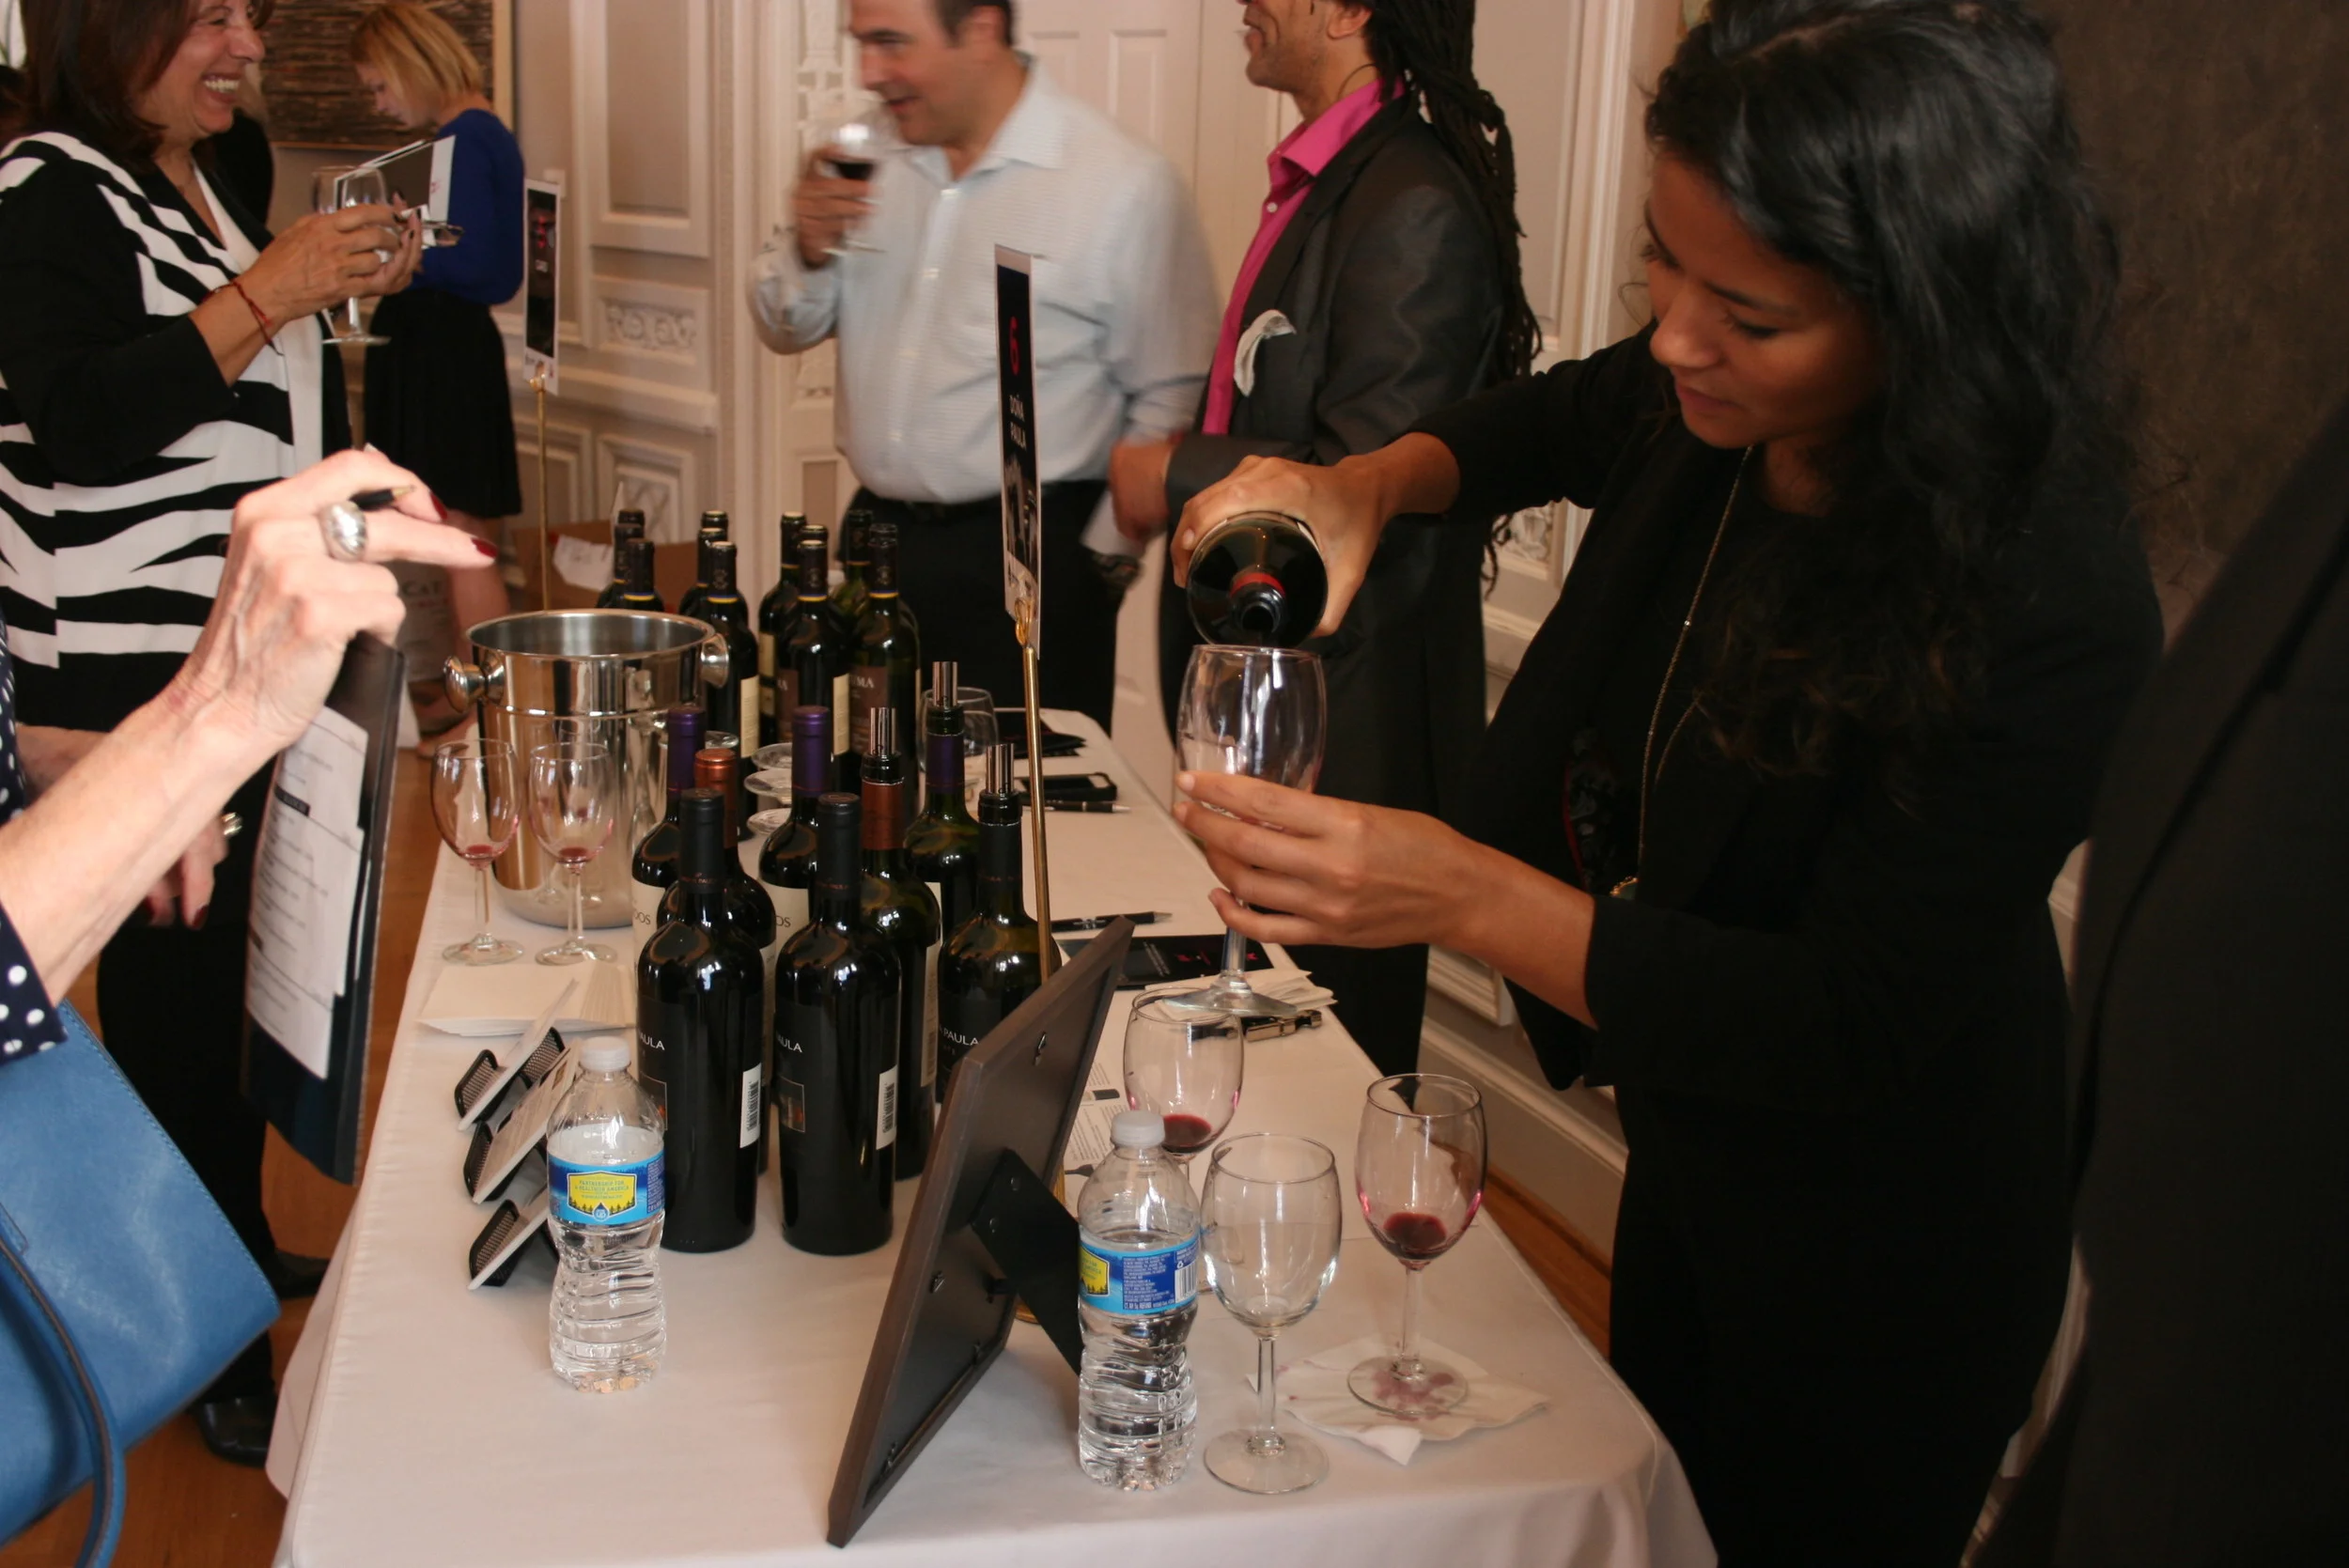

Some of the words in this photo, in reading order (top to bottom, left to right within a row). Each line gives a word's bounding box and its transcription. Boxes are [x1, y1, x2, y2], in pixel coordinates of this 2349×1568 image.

[1008, 316, 1020, 376] 6
[638, 1029, 665, 1050] AULA
[943, 1027, 979, 1046] PAULA
